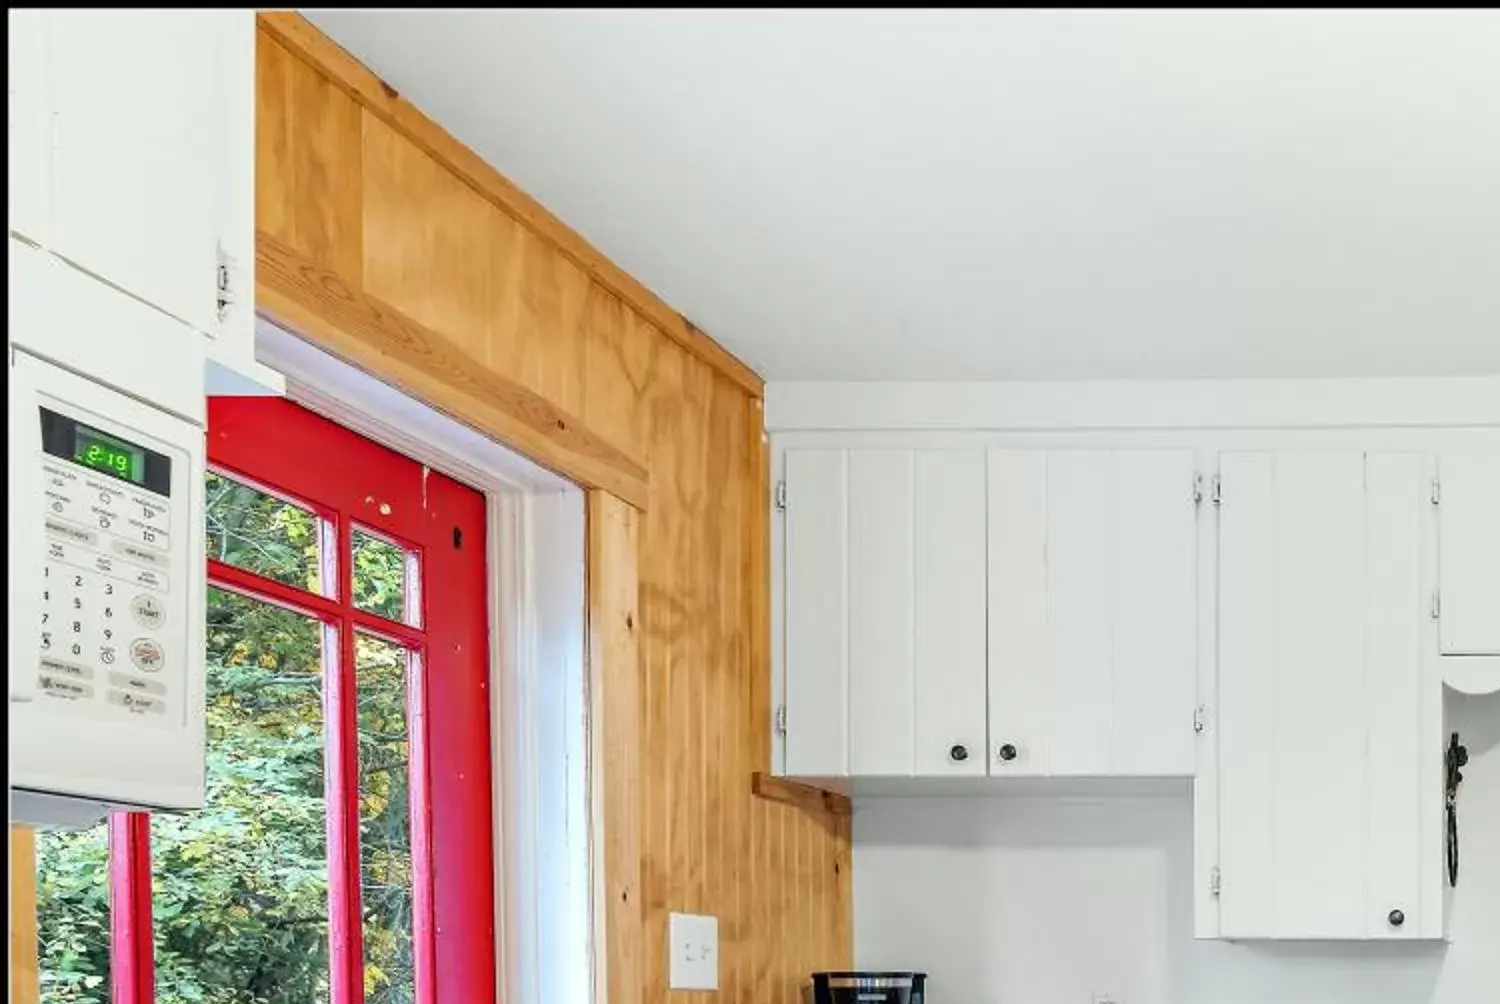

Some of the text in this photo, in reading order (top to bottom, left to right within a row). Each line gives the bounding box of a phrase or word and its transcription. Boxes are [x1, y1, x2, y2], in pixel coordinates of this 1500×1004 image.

[88, 445, 127, 470] 2:19
[75, 575, 82, 587] 2
[105, 584, 113, 595] 3
[105, 607, 113, 618] 6
[73, 621, 81, 632] 8
[104, 630, 112, 640] 9
[72, 644, 80, 655] 0
